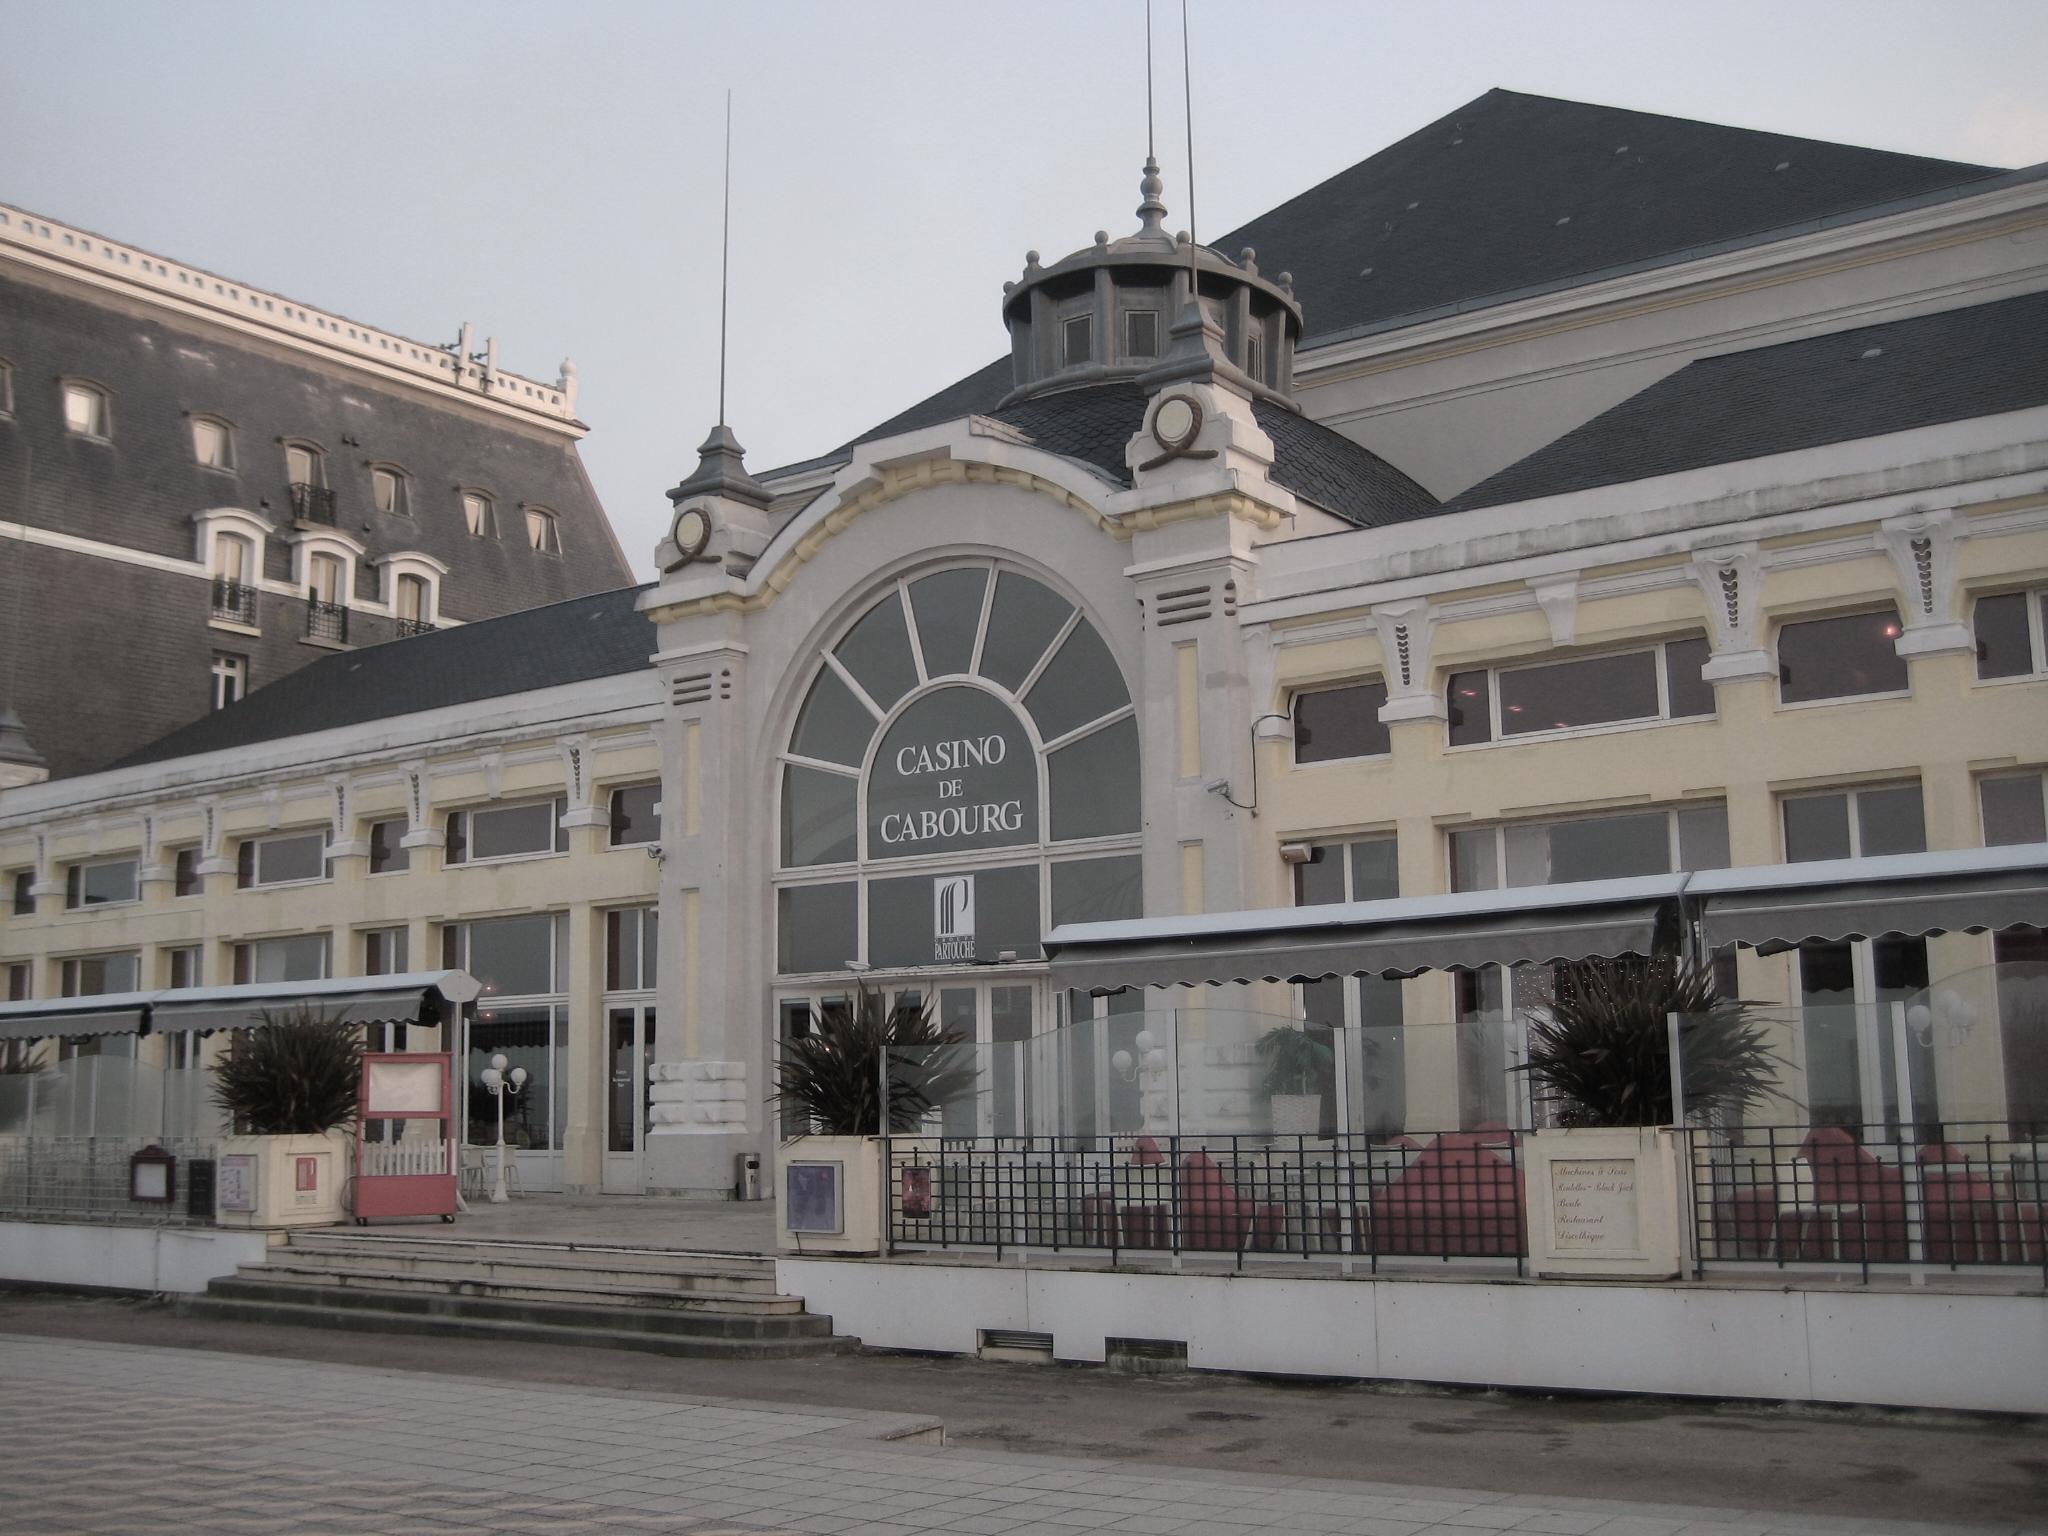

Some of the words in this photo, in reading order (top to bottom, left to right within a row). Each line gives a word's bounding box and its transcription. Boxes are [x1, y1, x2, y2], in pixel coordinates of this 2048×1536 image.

[896, 734, 1006, 776] CASINO
[938, 779, 964, 799] DE
[880, 799, 1024, 844] CABOURG
[934, 940, 976, 961] PARTOUCHE
[1555, 1167, 1594, 1176] Machines
[1557, 1215, 1604, 1224] Restaurant
